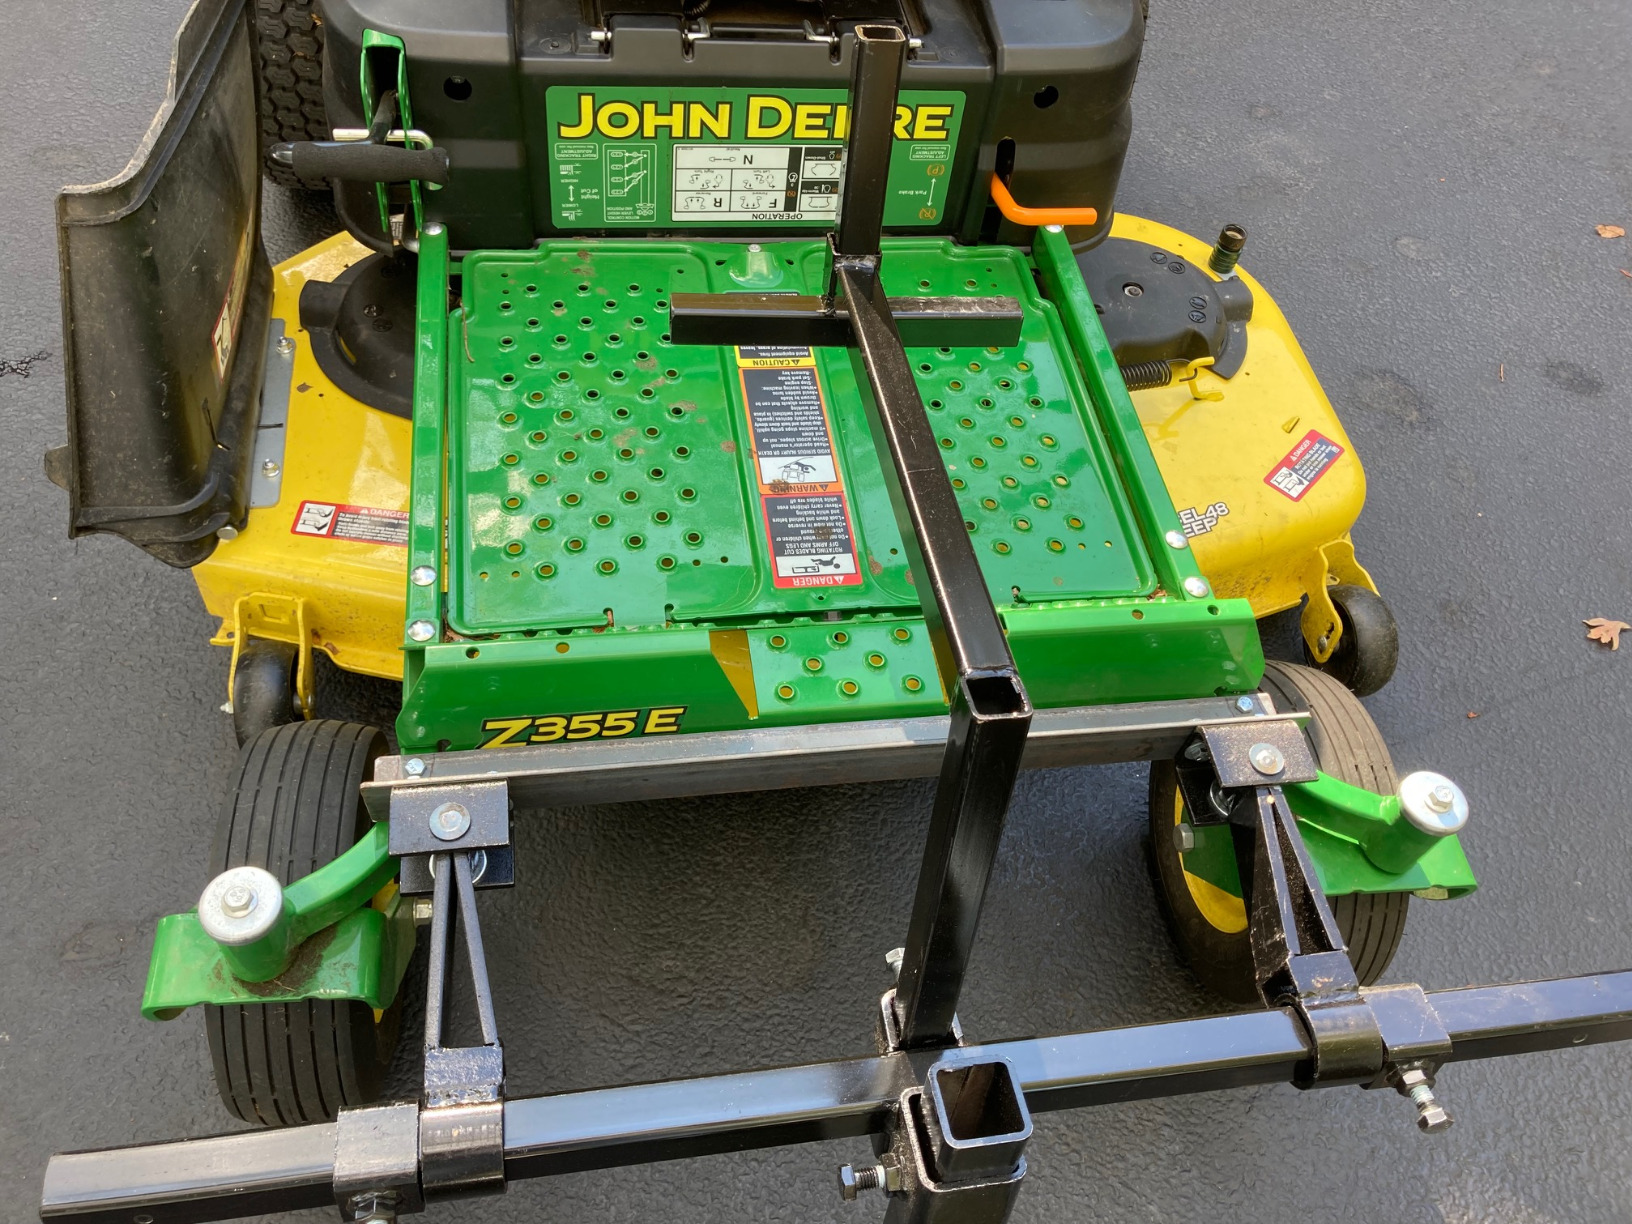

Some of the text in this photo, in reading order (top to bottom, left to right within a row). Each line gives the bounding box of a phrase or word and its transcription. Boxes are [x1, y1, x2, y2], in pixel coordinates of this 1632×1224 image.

[558, 93, 732, 139] JOHN
[743, 155, 753, 165] N
[713, 198, 722, 207] R
[769, 199, 777, 208] F
[1182, 516, 1218, 538] EEP
[792, 576, 833, 585] DANGER
[477, 707, 687, 750] Z355 E
